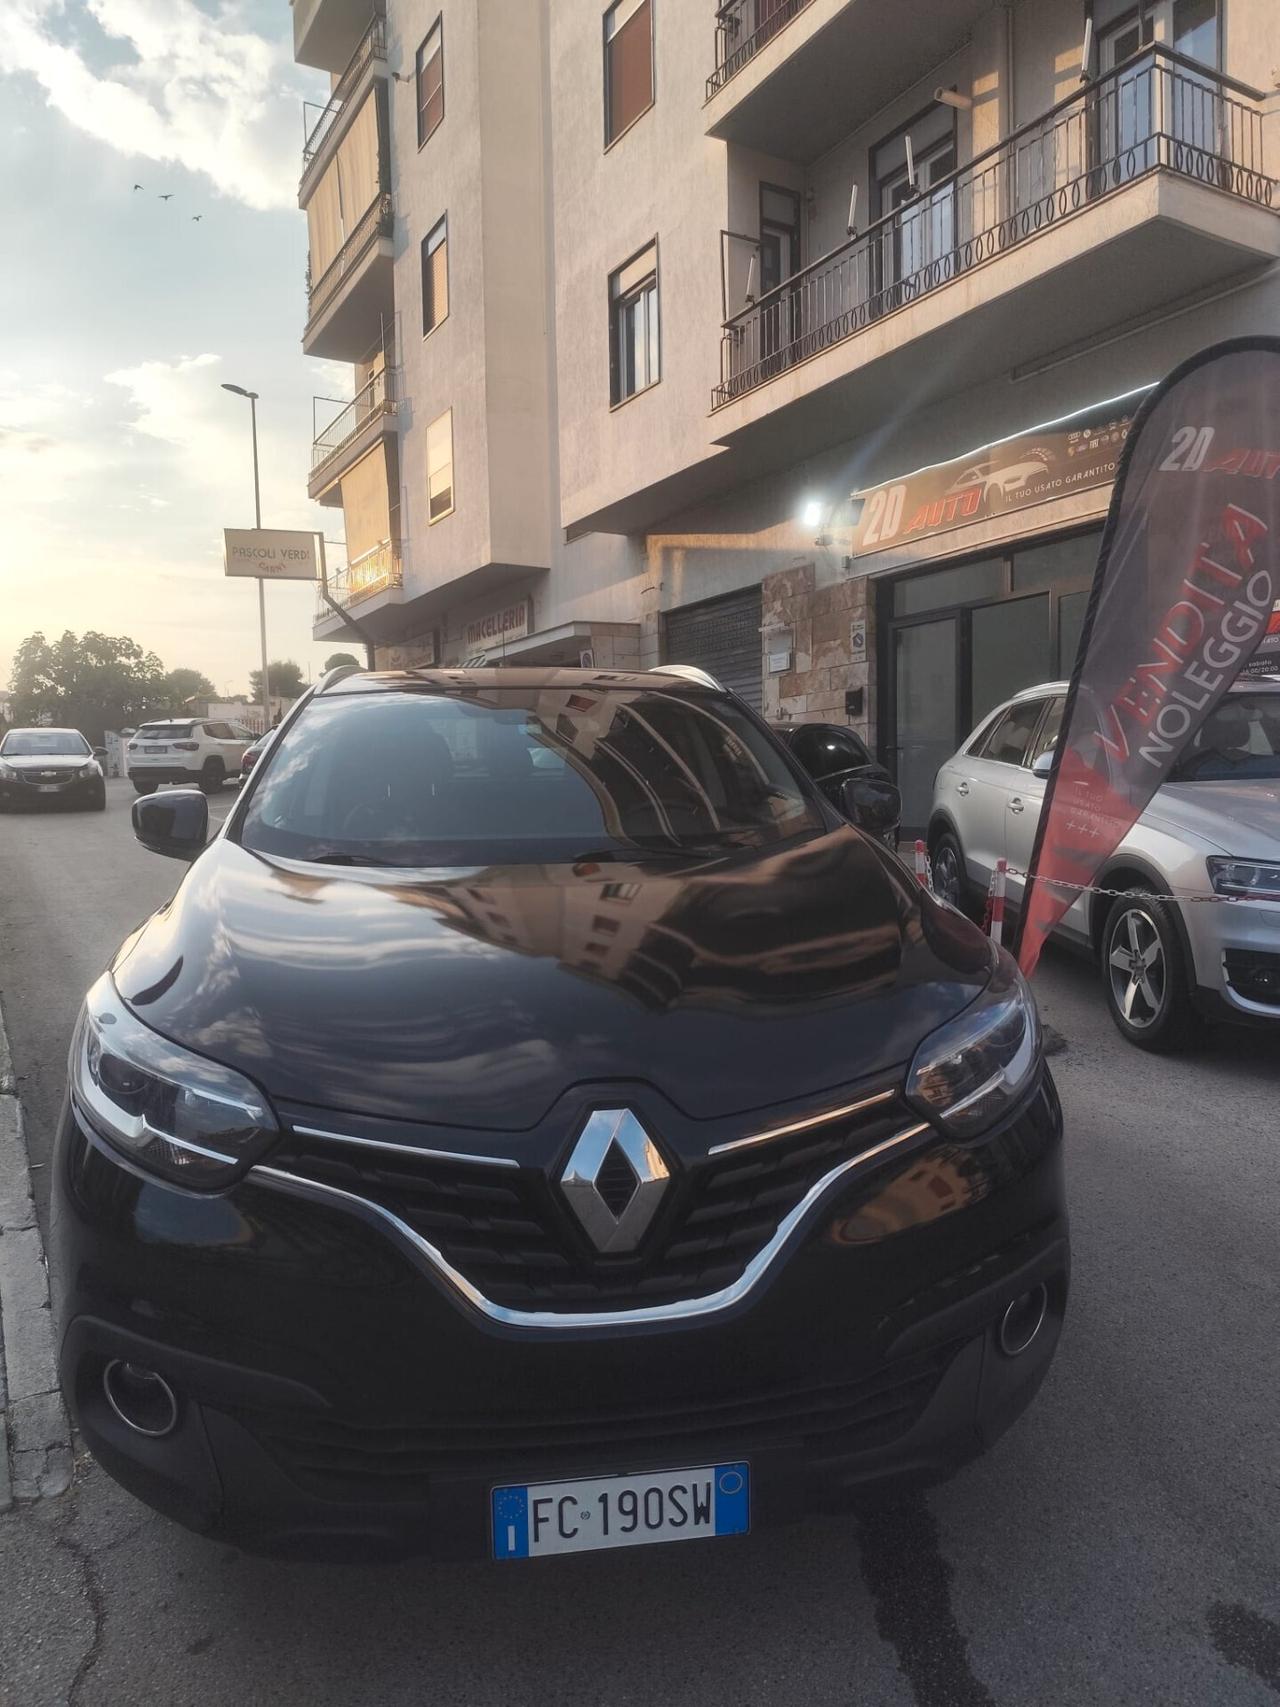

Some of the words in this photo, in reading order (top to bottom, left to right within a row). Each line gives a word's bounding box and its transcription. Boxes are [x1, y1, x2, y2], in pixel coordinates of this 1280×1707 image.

[1005, 496, 1012, 505] IL
[1015, 488, 1032, 498] TUO
[1034, 479, 1063, 493] USATO
[1065, 462, 1116, 484] GARANTITO
[902, 485, 982, 535] AUTO
[232, 546, 276, 559] PASCOLI
[280, 548, 311, 560] VERDI
[467, 604, 526, 645] MACELLERIA
[1092, 502, 1269, 762] VENDITA
[1138, 569, 1273, 769] NOLEGGIO
[532, 1495, 579, 1543] FC
[598, 1481, 712, 1536] 190SW
